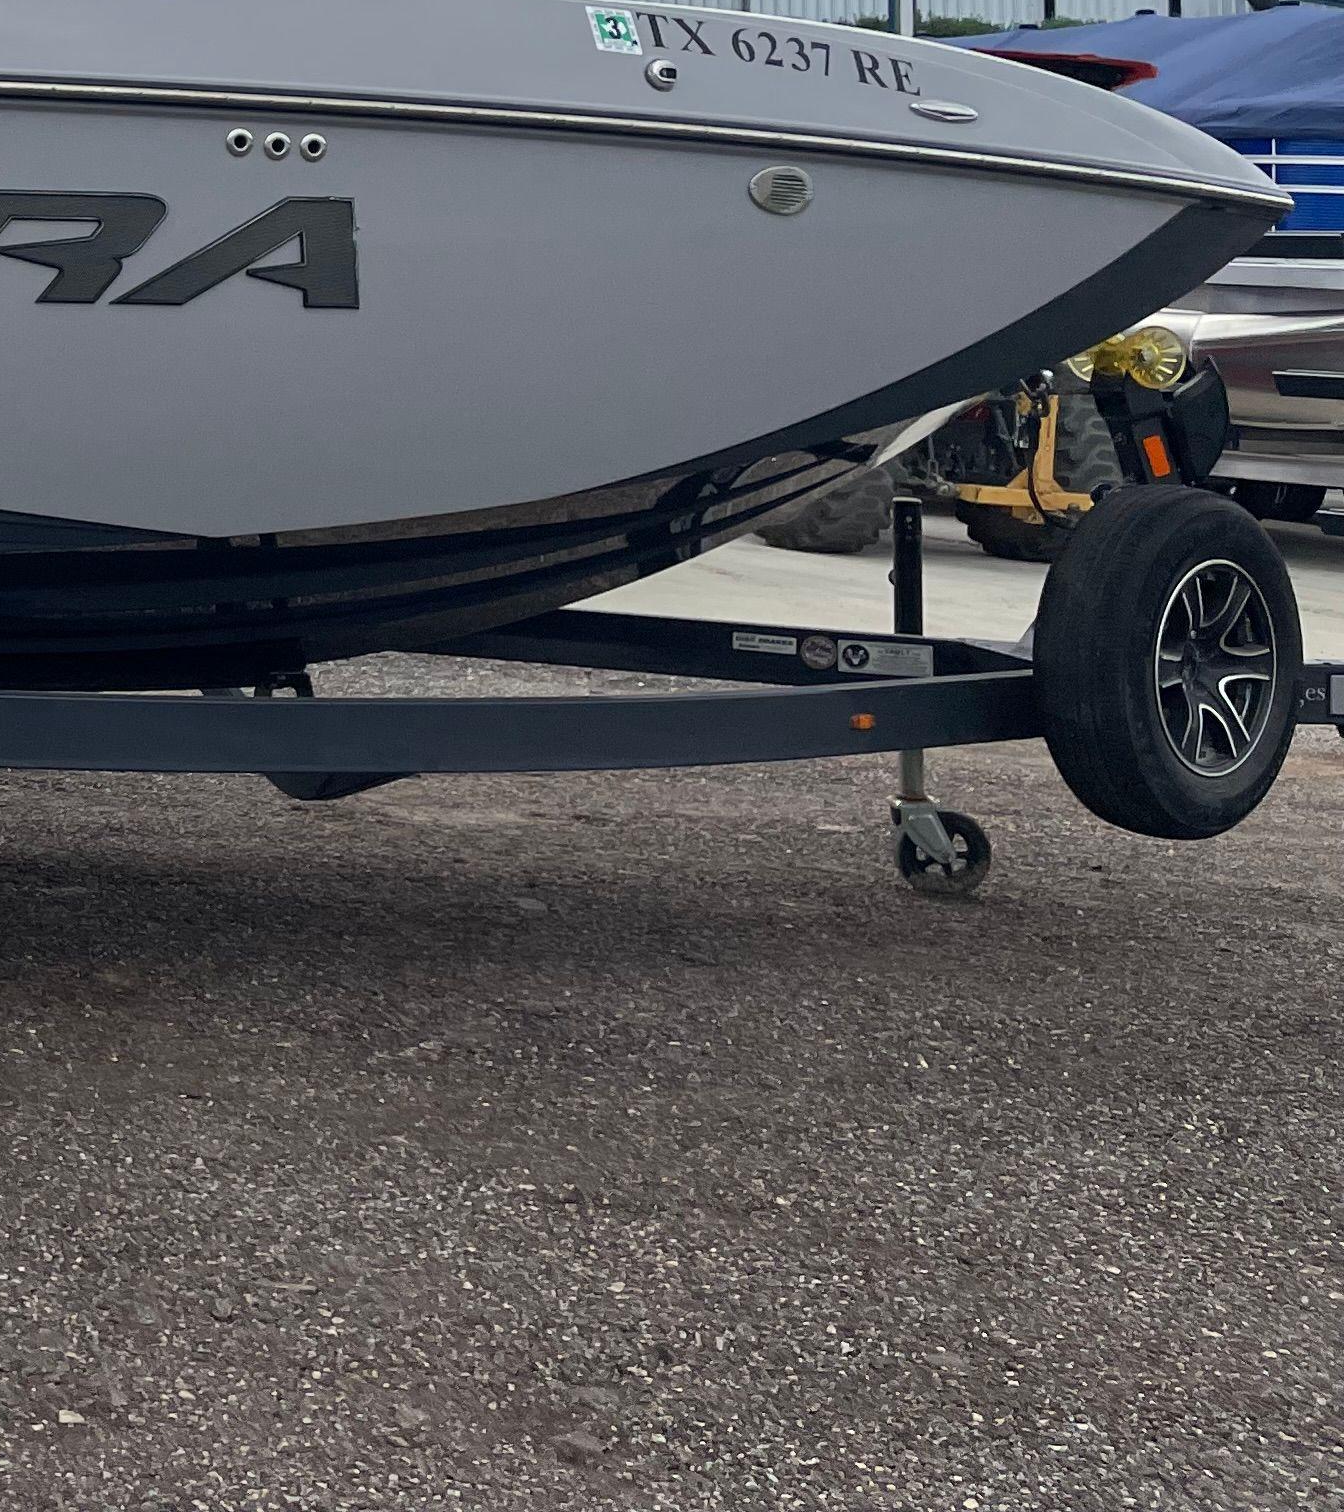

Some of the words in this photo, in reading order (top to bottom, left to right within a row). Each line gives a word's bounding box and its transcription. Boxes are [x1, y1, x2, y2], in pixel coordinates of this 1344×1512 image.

[605, 16, 622, 39] 3
[635, 11, 717, 56] TX
[730, 27, 832, 77] 6237
[849, 48, 923, 96] RE
